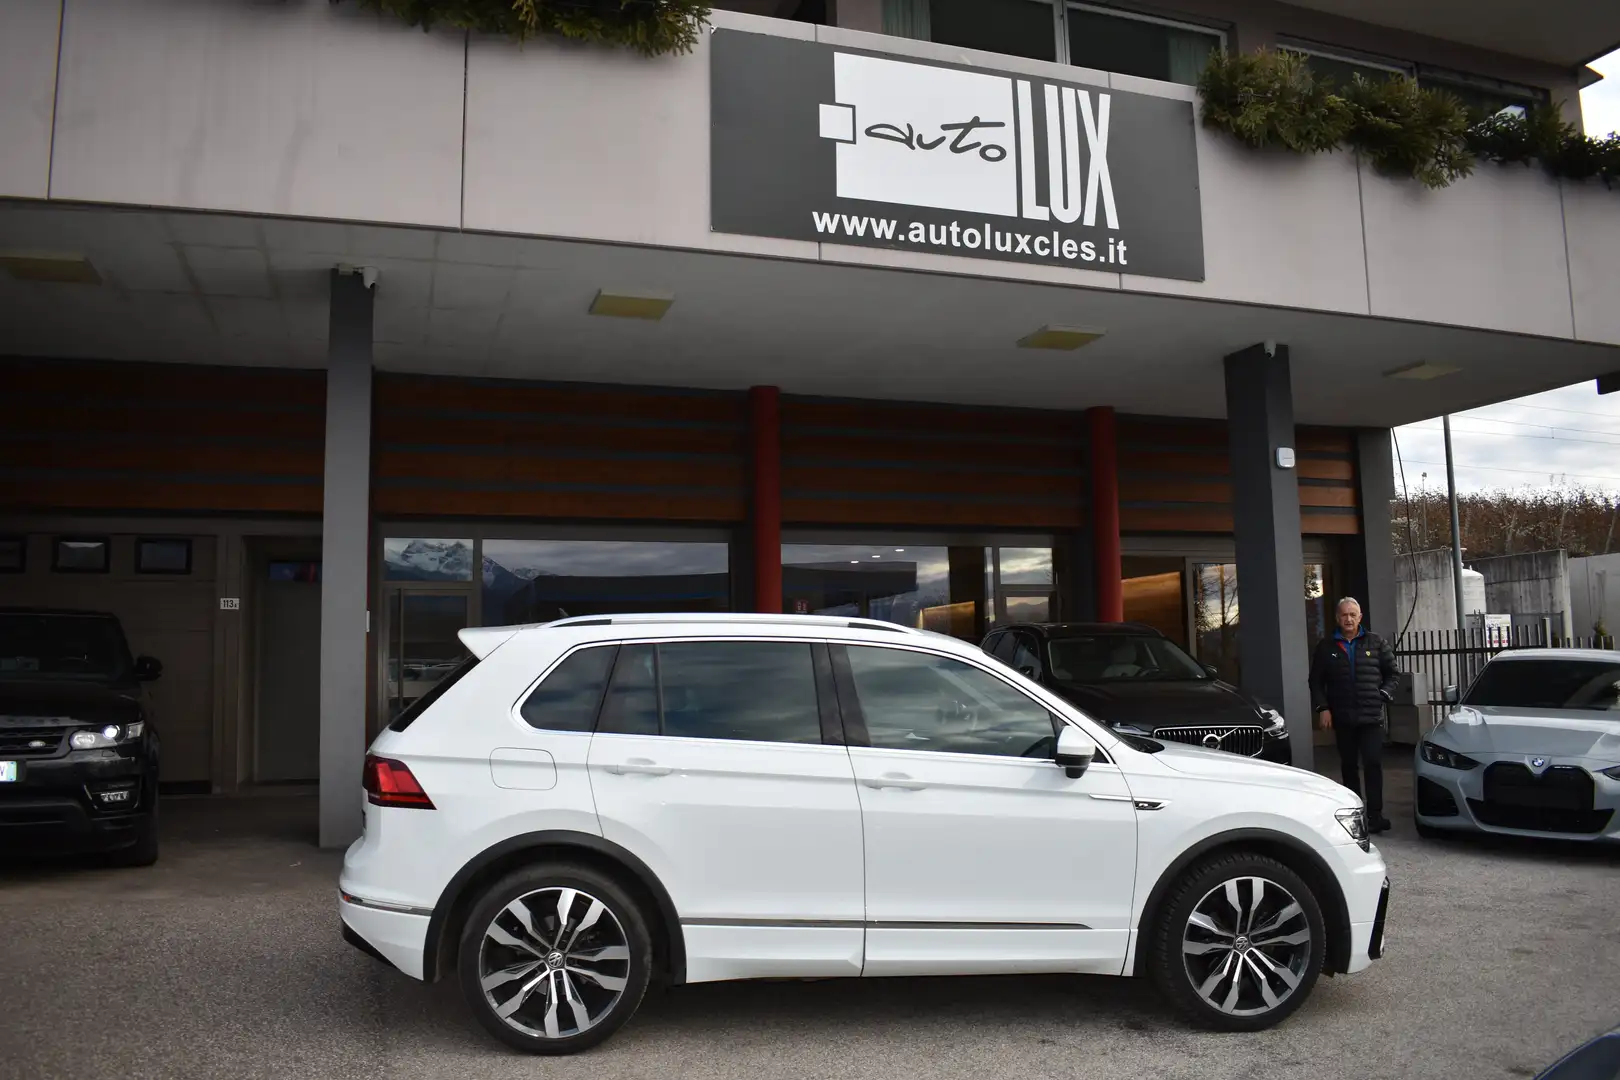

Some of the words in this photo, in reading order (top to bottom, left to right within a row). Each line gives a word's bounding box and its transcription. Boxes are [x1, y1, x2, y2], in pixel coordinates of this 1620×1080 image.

[864, 116, 1007, 162] auto
[1016, 79, 1119, 230] LUX
[812, 211, 1128, 265] www.autoluxcles.it
